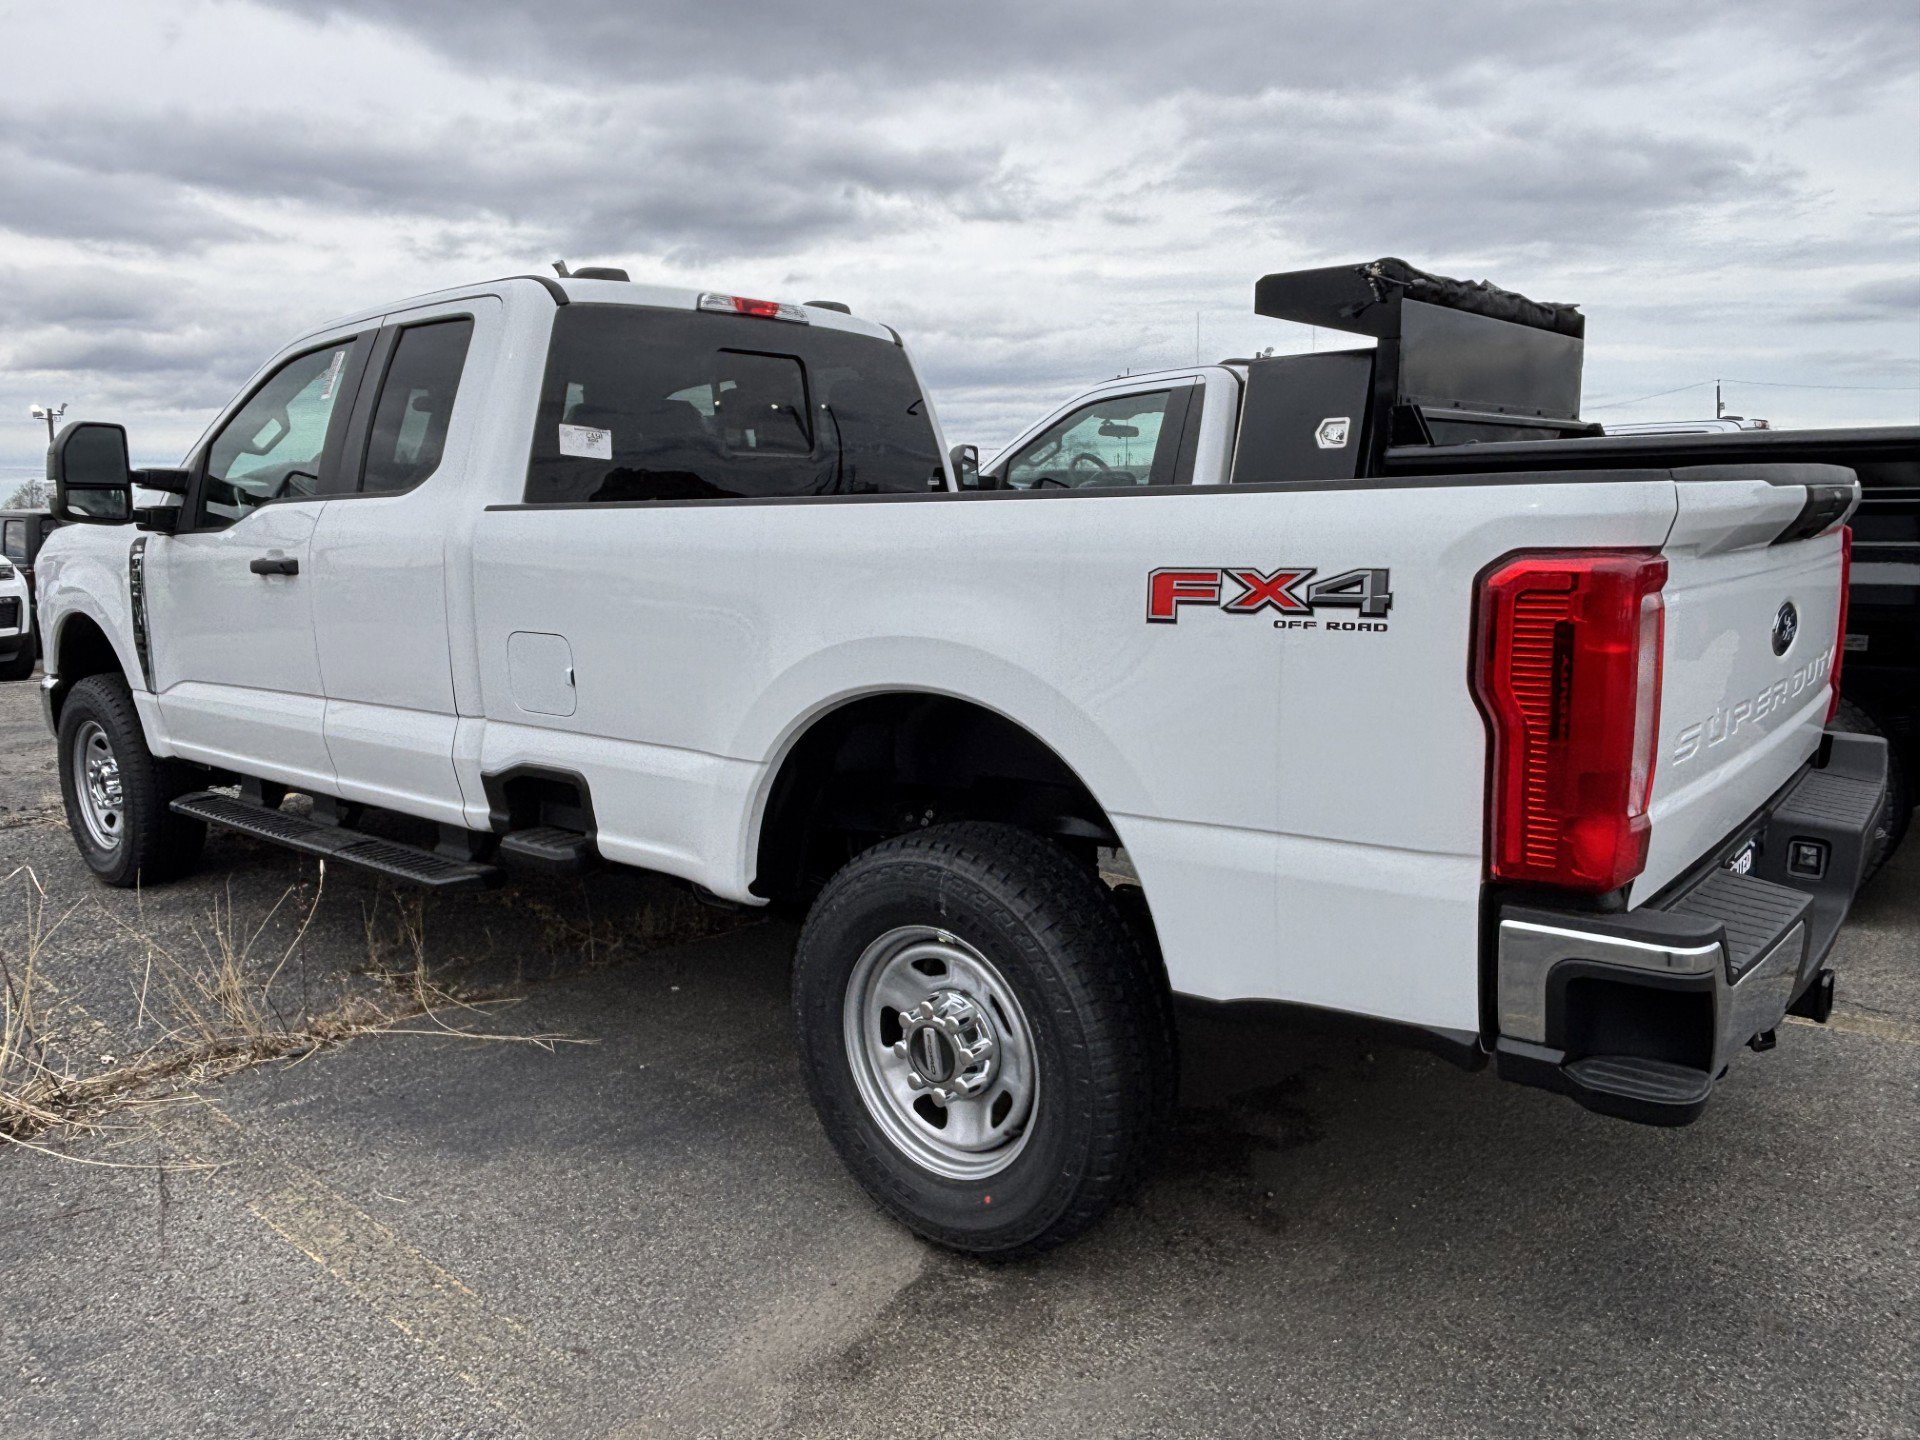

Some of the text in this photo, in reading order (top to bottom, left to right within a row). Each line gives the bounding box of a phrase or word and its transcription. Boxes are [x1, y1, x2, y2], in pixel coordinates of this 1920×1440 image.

[1146, 567, 1393, 624] FX4
[1273, 620, 1388, 633] OFF ROAD
[1673, 678, 1788, 767] SUPER
